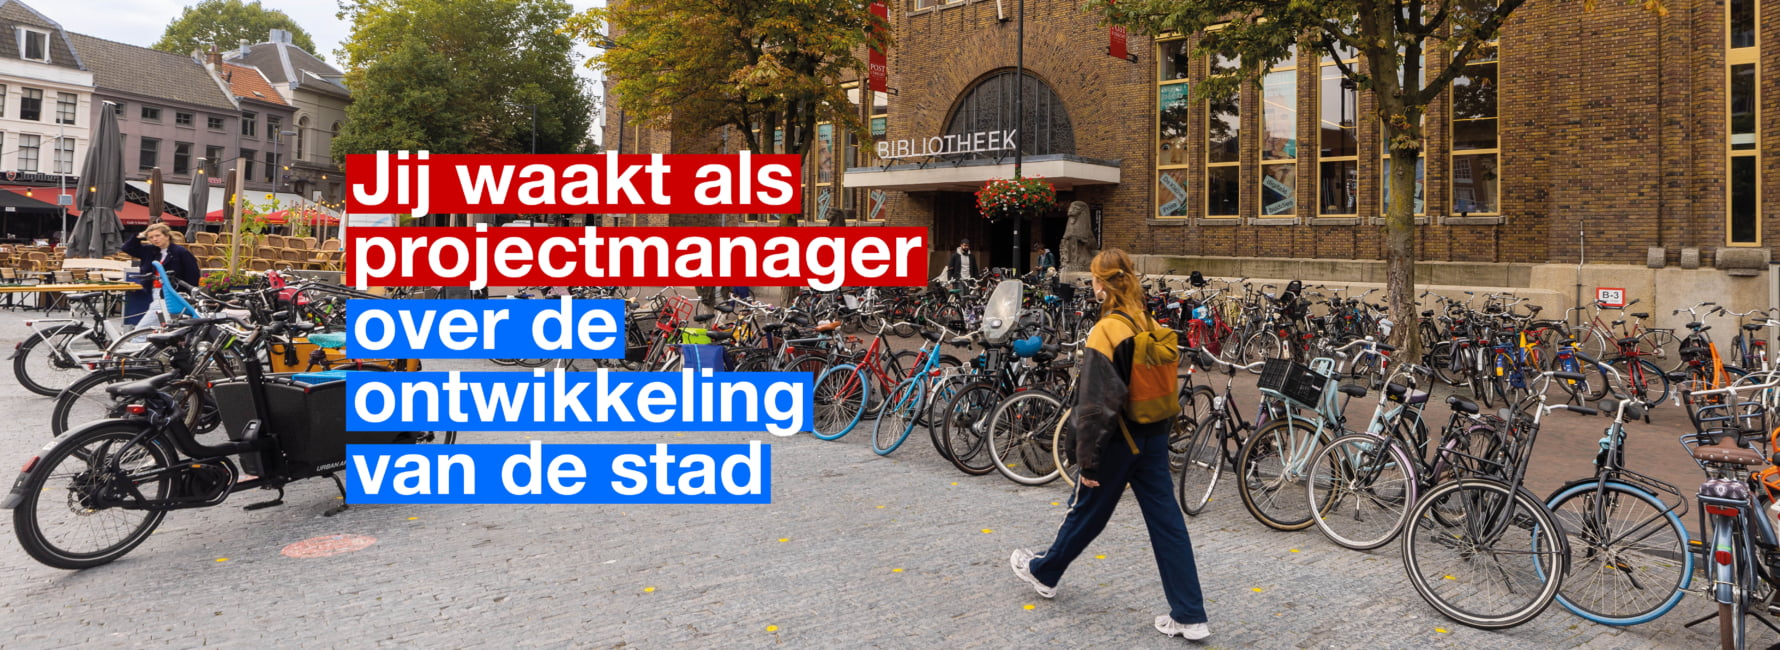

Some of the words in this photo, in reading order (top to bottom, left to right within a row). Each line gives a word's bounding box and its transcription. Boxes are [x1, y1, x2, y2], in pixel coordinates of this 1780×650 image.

[870, 63, 885, 72] POST
[877, 128, 1017, 159] BIBLIOTHEEK
[1602, 291, 1619, 299] B-3
